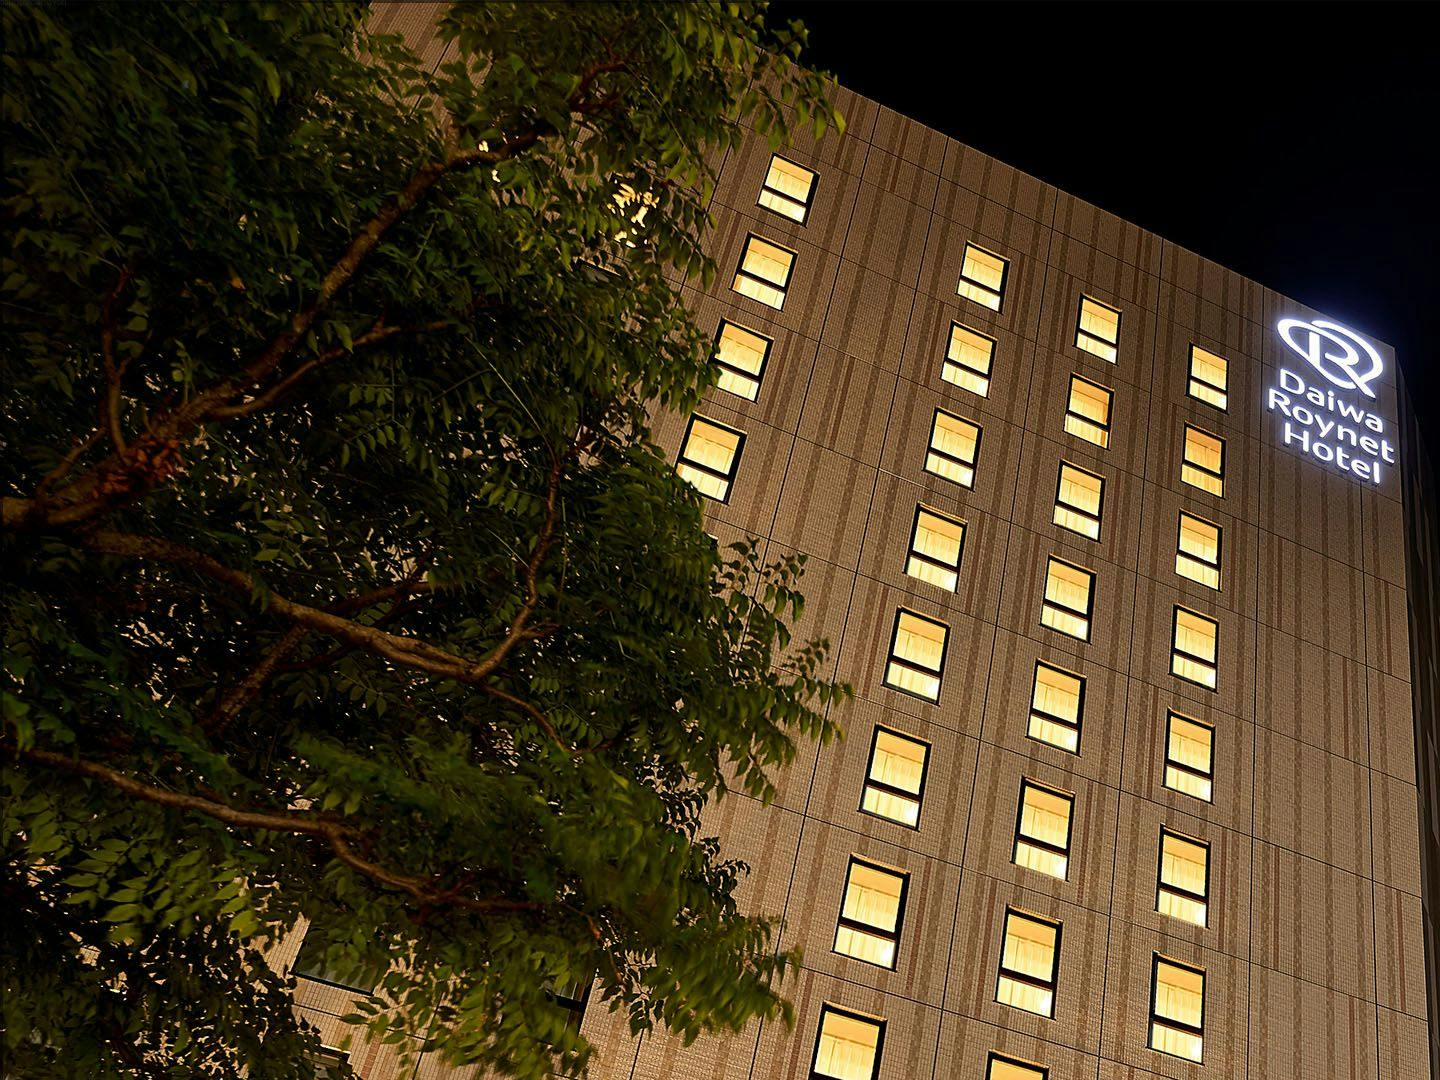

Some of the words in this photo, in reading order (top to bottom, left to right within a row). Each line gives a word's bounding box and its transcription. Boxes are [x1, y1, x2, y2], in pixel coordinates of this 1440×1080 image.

[1268, 388, 1395, 464] Roynet
[1280, 368, 1384, 433] Daiwa
[1284, 422, 1381, 484] Hotel
